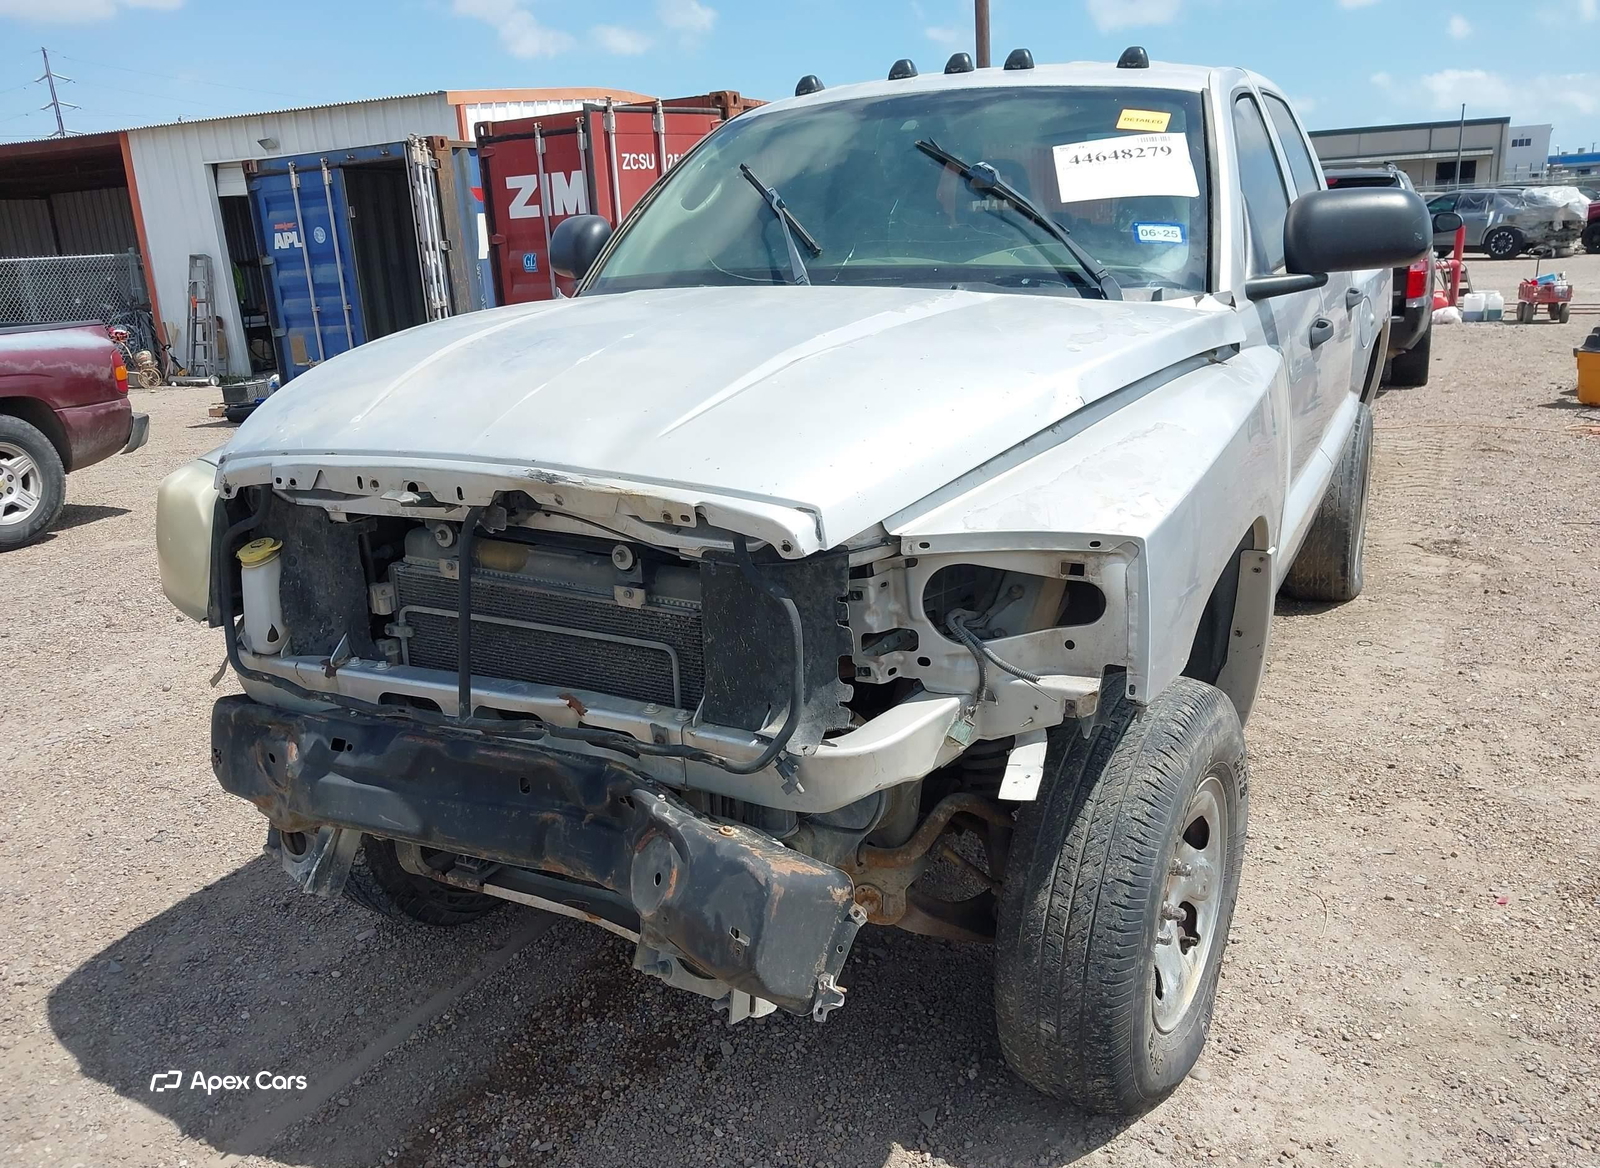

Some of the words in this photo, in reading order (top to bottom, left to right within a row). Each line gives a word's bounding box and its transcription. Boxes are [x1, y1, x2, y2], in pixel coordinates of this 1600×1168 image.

[1123, 116, 1163, 125] DETAILED
[621, 153, 655, 170] ZCSU
[1068, 145, 1172, 165] 44648279
[505, 170, 587, 219] ZIM
[274, 231, 303, 250] APL
